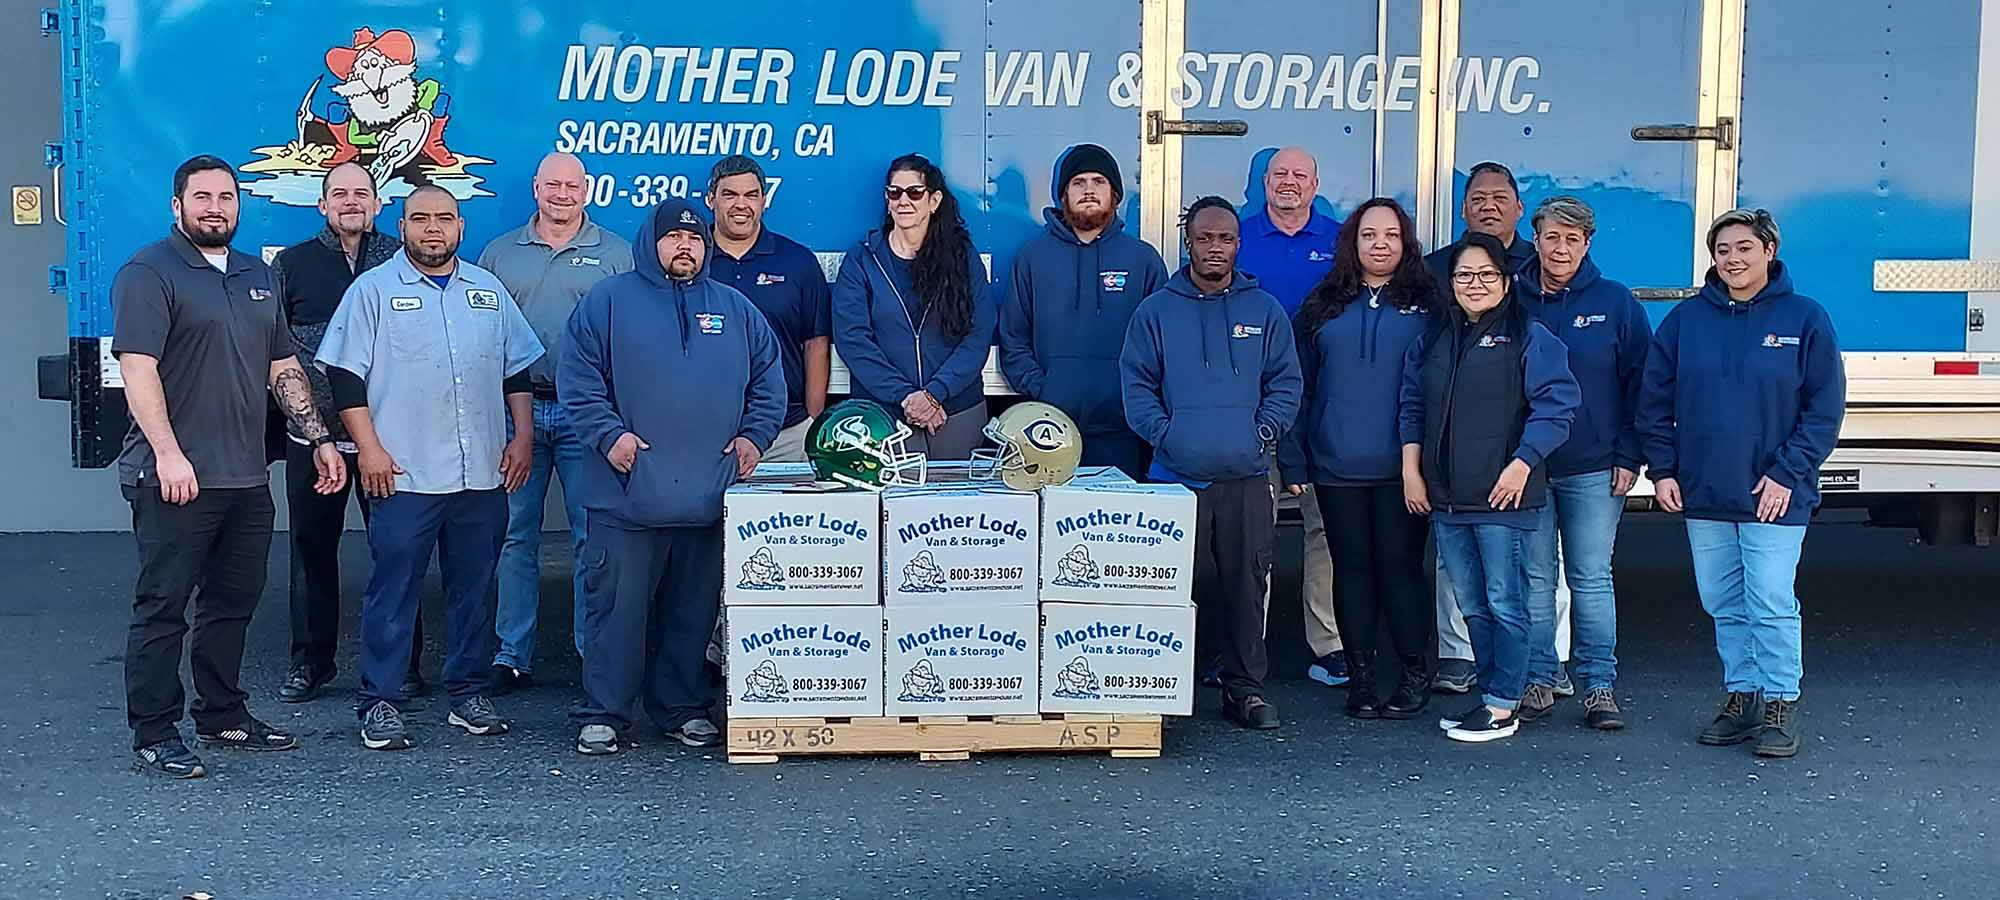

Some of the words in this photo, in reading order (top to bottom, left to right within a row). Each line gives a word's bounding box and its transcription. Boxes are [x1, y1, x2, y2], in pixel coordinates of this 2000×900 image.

[558, 45, 794, 105] MOTHER
[815, 49, 960, 107] LODE
[985, 51, 1090, 107] VAN
[1108, 51, 1143, 108] &
[1171, 52, 1420, 111] STORAGE
[1445, 56, 1550, 113] INC.
[556, 120, 780, 160] SACRAMENTO,
[794, 124, 834, 156] CA
[737, 512, 814, 541] Mother
[819, 513, 868, 541] Lode
[898, 513, 974, 544] Mother
[979, 513, 1027, 541] Lode
[1056, 509, 1132, 536] Mother
[1136, 512, 1184, 541] Lode
[765, 535, 786, 544] Van
[789, 535, 798, 544] &
[801, 535, 845, 546] Storage
[925, 537, 946, 546] Van
[950, 537, 958, 546] &
[961, 537, 1005, 547] Storage
[1082, 532, 1103, 541] Van
[1106, 533, 1115, 542] &
[1118, 533, 1162, 546] Storage
[789, 566, 863, 578] 800-339-3067
[950, 568, 1023, 580] 800-339-3067
[1104, 565, 1177, 579] 800-339-3067
[741, 624, 817, 653] Mother
[822, 624, 871, 652] Lode
[897, 624, 973, 653] Mother
[979, 624, 1027, 651] Lode
[1055, 622, 1131, 649] Mother
[1136, 624, 1183, 652] Lode
[768, 647, 789, 656] Van
[793, 647, 801, 656] &
[805, 647, 848, 658] Storage
[925, 647, 946, 656] Van
[949, 647, 957, 656] &
[960, 647, 1004, 658] Storage
[1081, 644, 1103, 654] Van
[1106, 645, 1114, 654] &
[1117, 646, 1161, 657] Storage
[792, 679, 867, 690] 800-339-3067
[949, 677, 1022, 690] 800-339-3067
[1104, 676, 1177, 689] 800-339-3067
[747, 729, 776, 748] 42
[782, 729, 796, 747] X
[807, 727, 835, 747] 50
